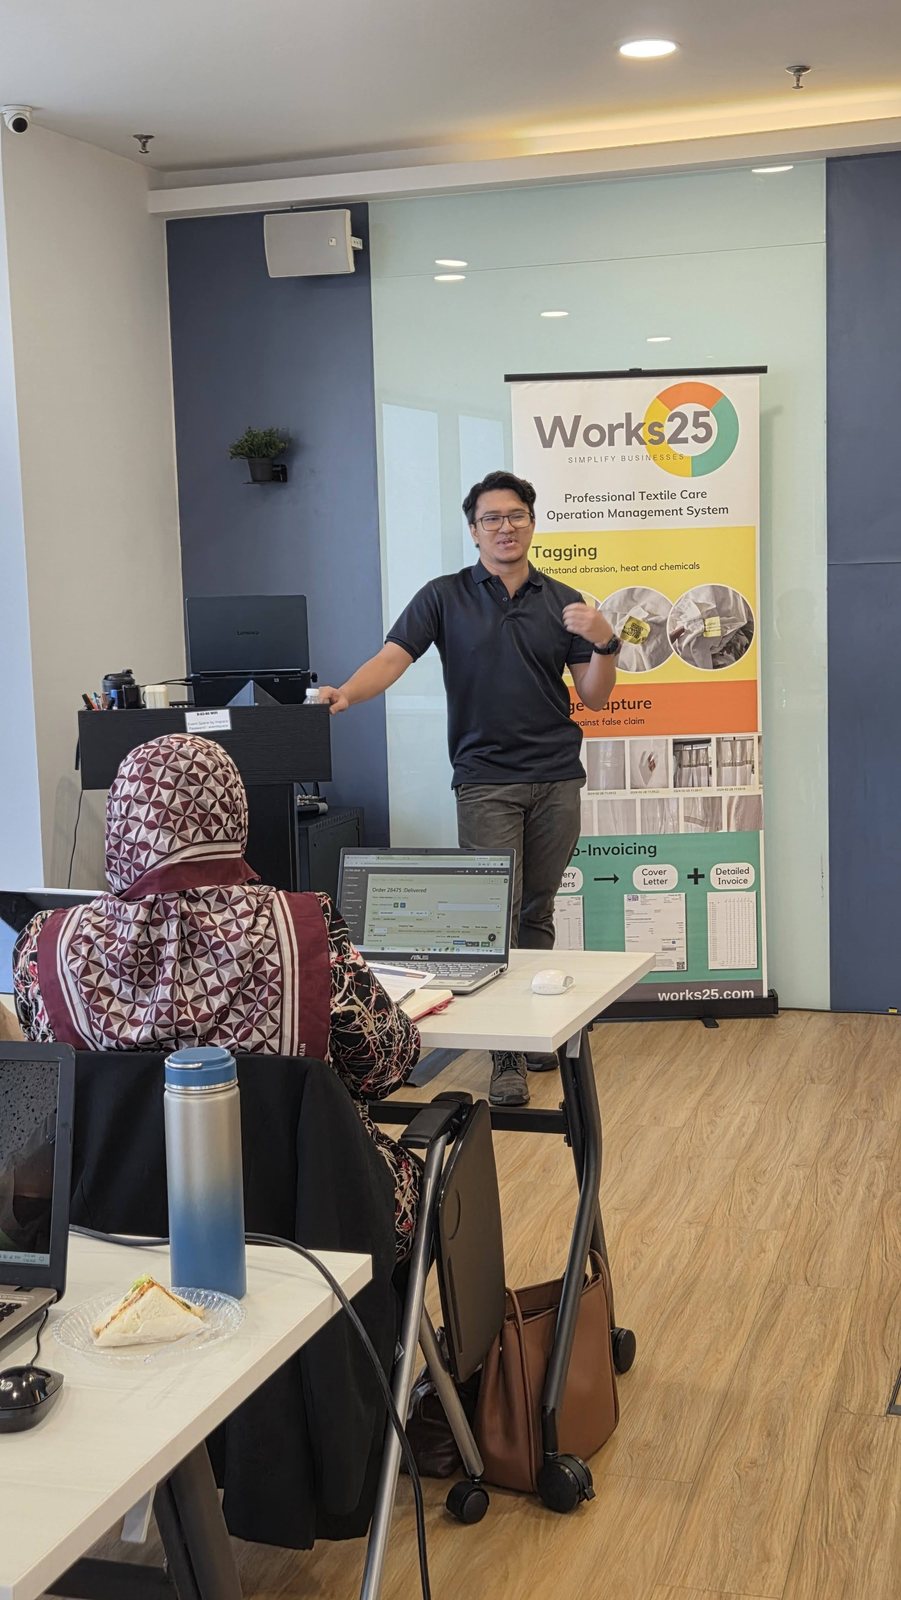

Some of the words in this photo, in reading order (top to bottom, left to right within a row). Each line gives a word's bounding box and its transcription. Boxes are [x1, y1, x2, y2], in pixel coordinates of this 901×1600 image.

[533, 411, 713, 449] Works25
[567, 455, 616, 464] SIMPLIFY
[620, 453, 685, 463] BUSINESSES
[564, 491, 636, 504] Professional
[638, 489, 677, 501] Textile
[680, 488, 708, 500] Care
[546, 508, 604, 522] Operation
[607, 506, 684, 521] Management
[687, 505, 729, 518] System
[531, 544, 597, 561] Tagging
[579, 565, 618, 574] abrasion,
[620, 564, 640, 573] heat
[642, 563, 658, 572] and
[659, 561, 701, 571] chemicals
[602, 698, 652, 714] apture
[602, 717, 622, 726] false
[623, 717, 645, 725] claim
[573, 842, 658, 858] o-Invoicing
[641, 868, 668, 877] Cover
[715, 866, 750, 876] Detailed
[643, 877, 668, 886] Letter
[718, 876, 749, 886] Invoice
[657, 988, 754, 1001] works25.com
